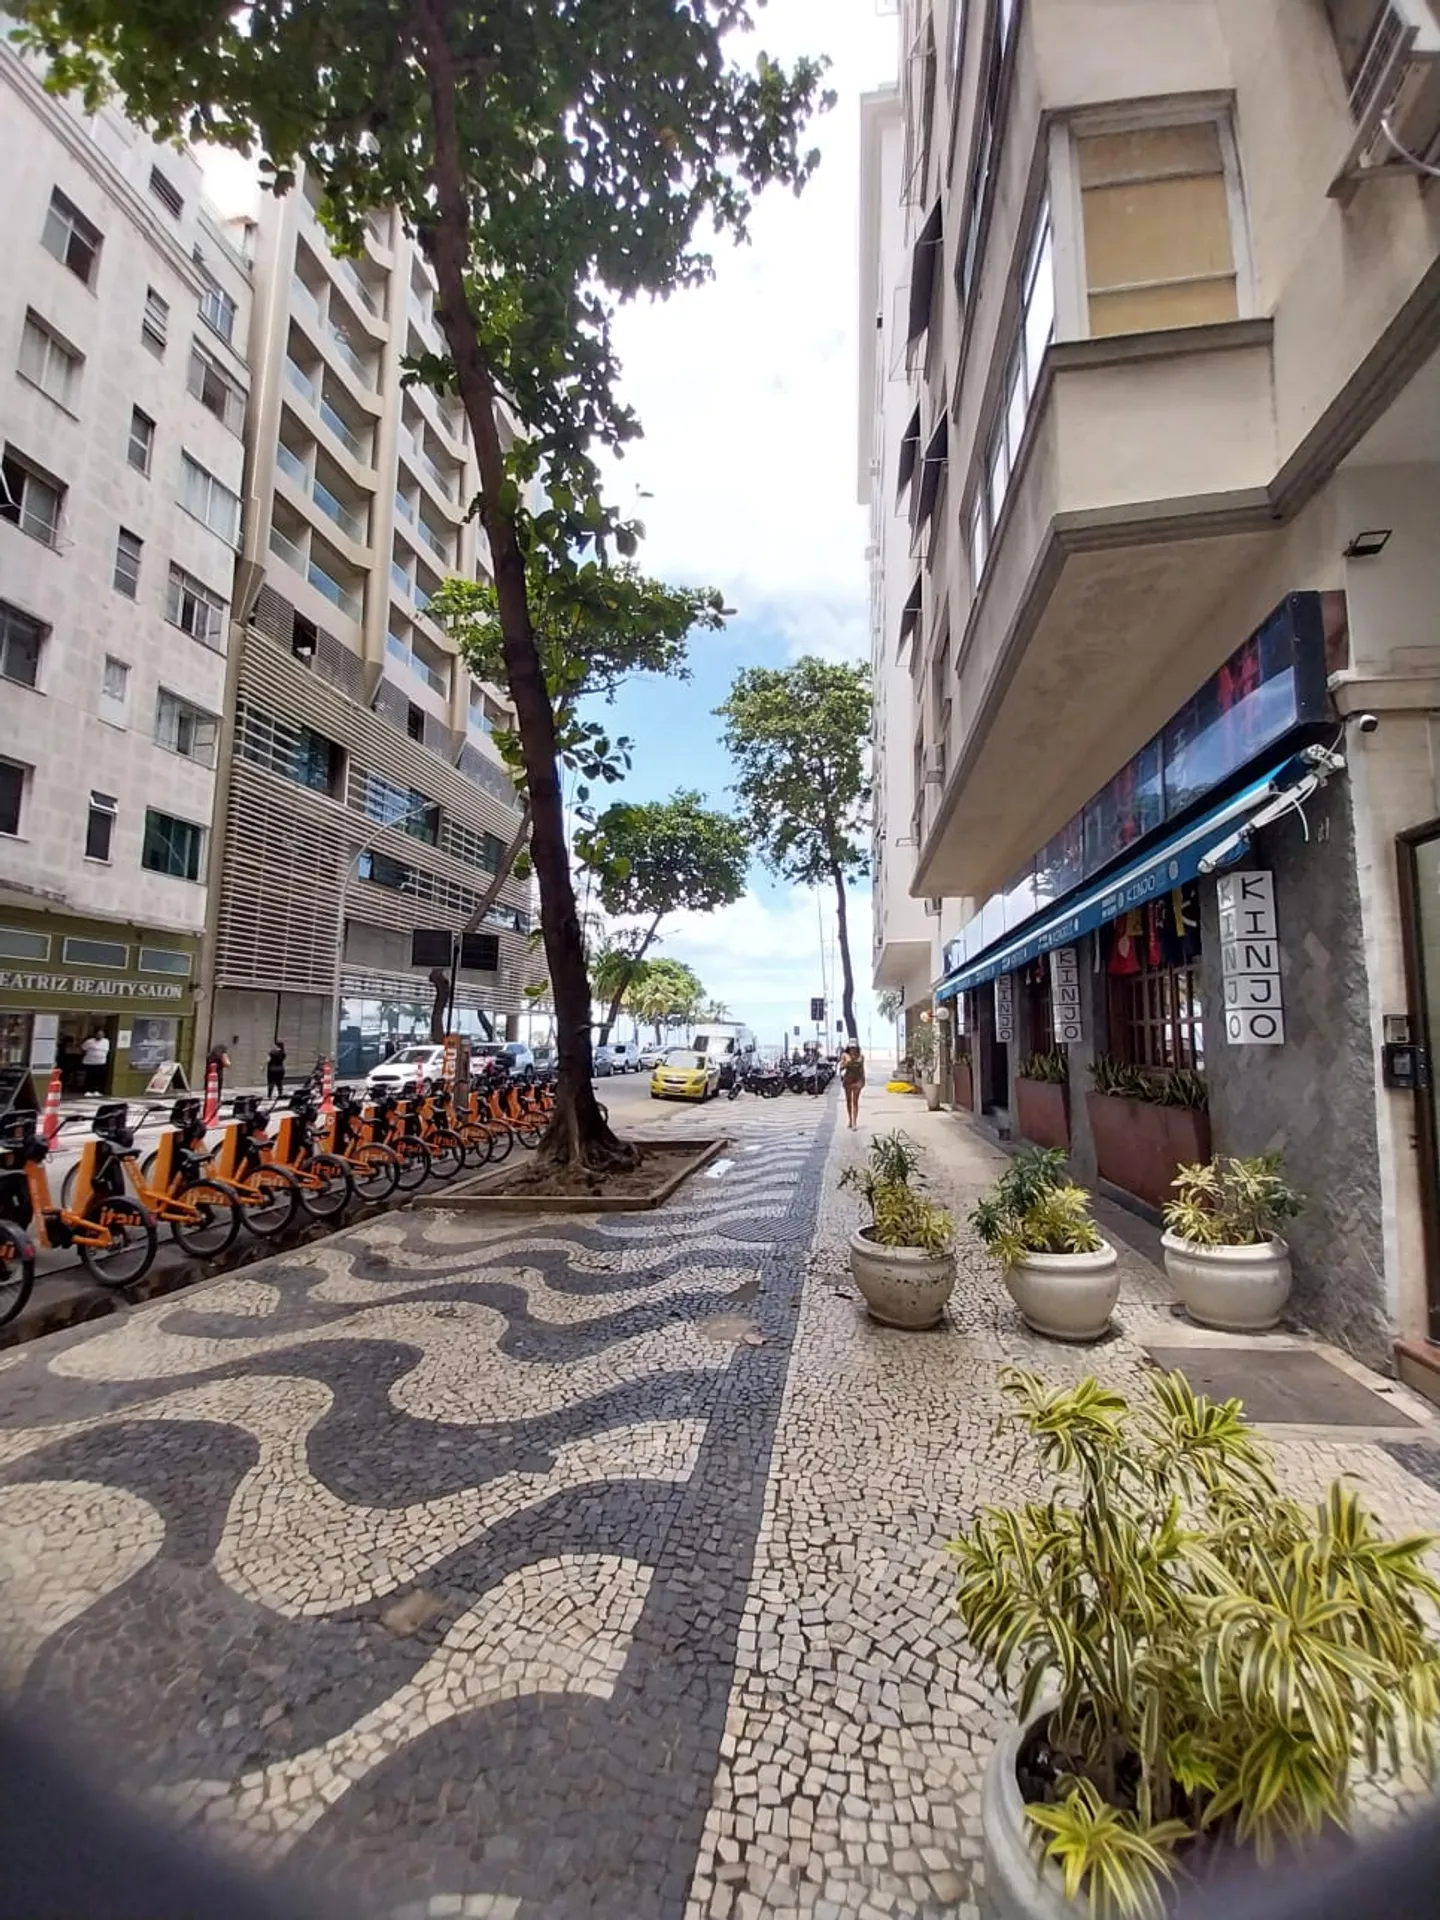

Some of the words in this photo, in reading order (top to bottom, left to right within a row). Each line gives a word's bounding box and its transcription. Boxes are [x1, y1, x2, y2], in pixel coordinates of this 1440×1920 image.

[0, 972, 69, 991] EATRIZ
[72, 978, 137, 996] BEAUTY
[138, 983, 183, 999] SALON
[1059, 951, 1079, 1039] KINJO
[1219, 878, 1242, 1039] KINJO
[1241, 876, 1277, 1039] KINJO
